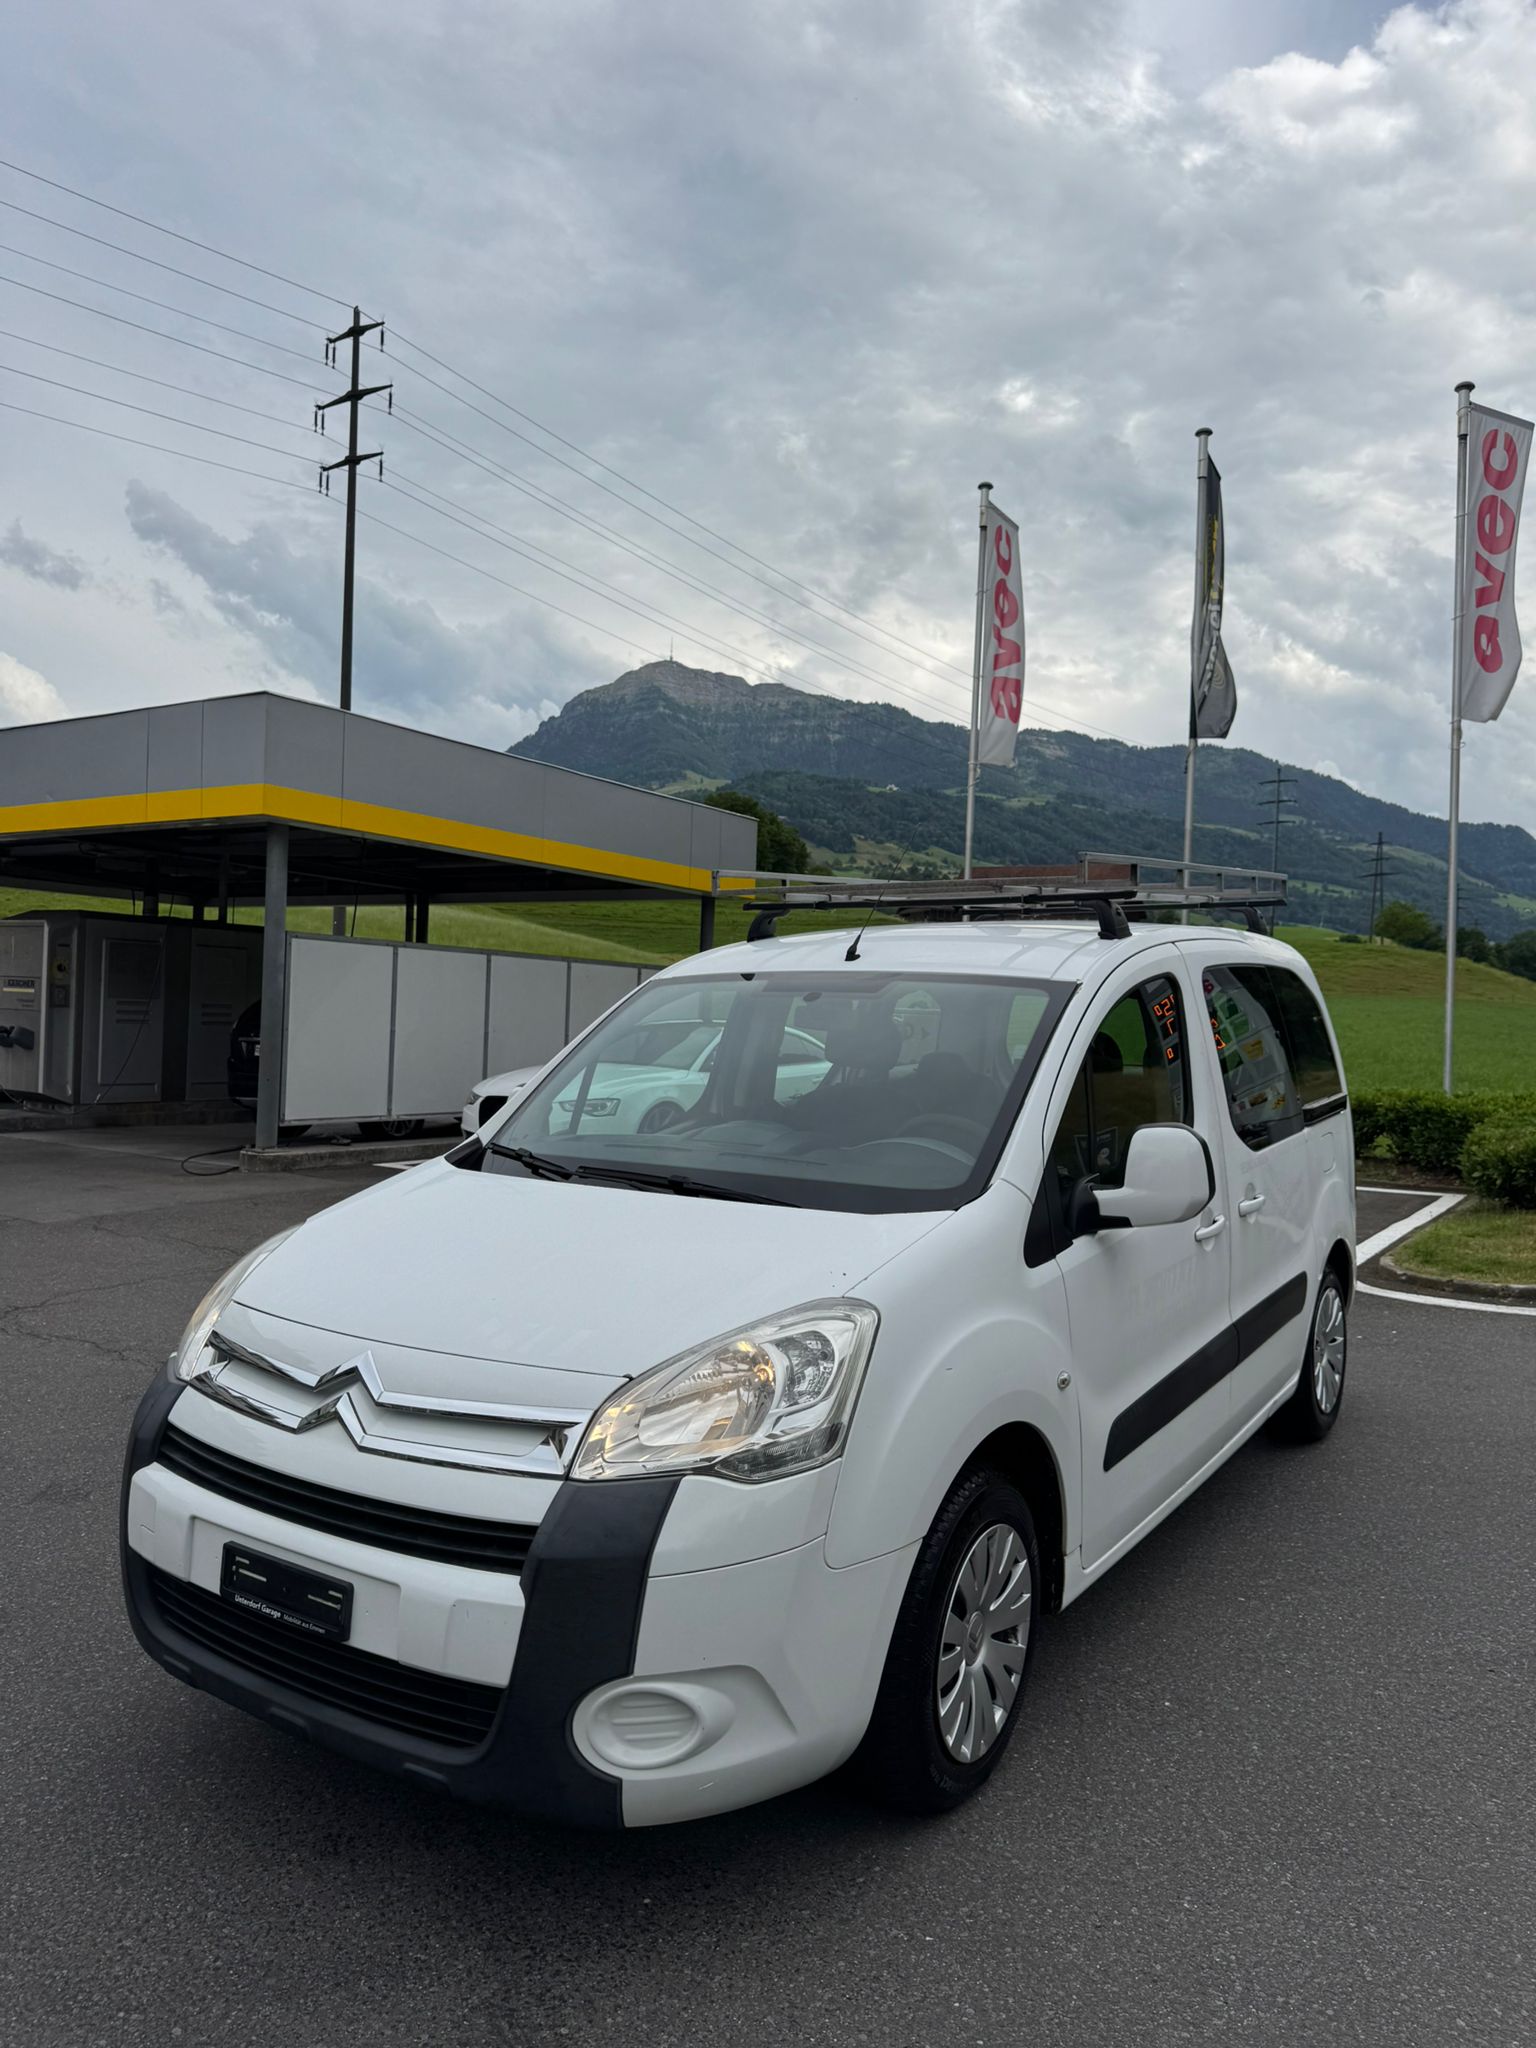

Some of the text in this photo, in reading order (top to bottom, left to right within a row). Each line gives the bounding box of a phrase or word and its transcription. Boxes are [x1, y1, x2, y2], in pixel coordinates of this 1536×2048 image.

[990, 524, 1022, 724] avec
[1473, 428, 1518, 673] avec
[261, 1603, 281, 1618] Garage
